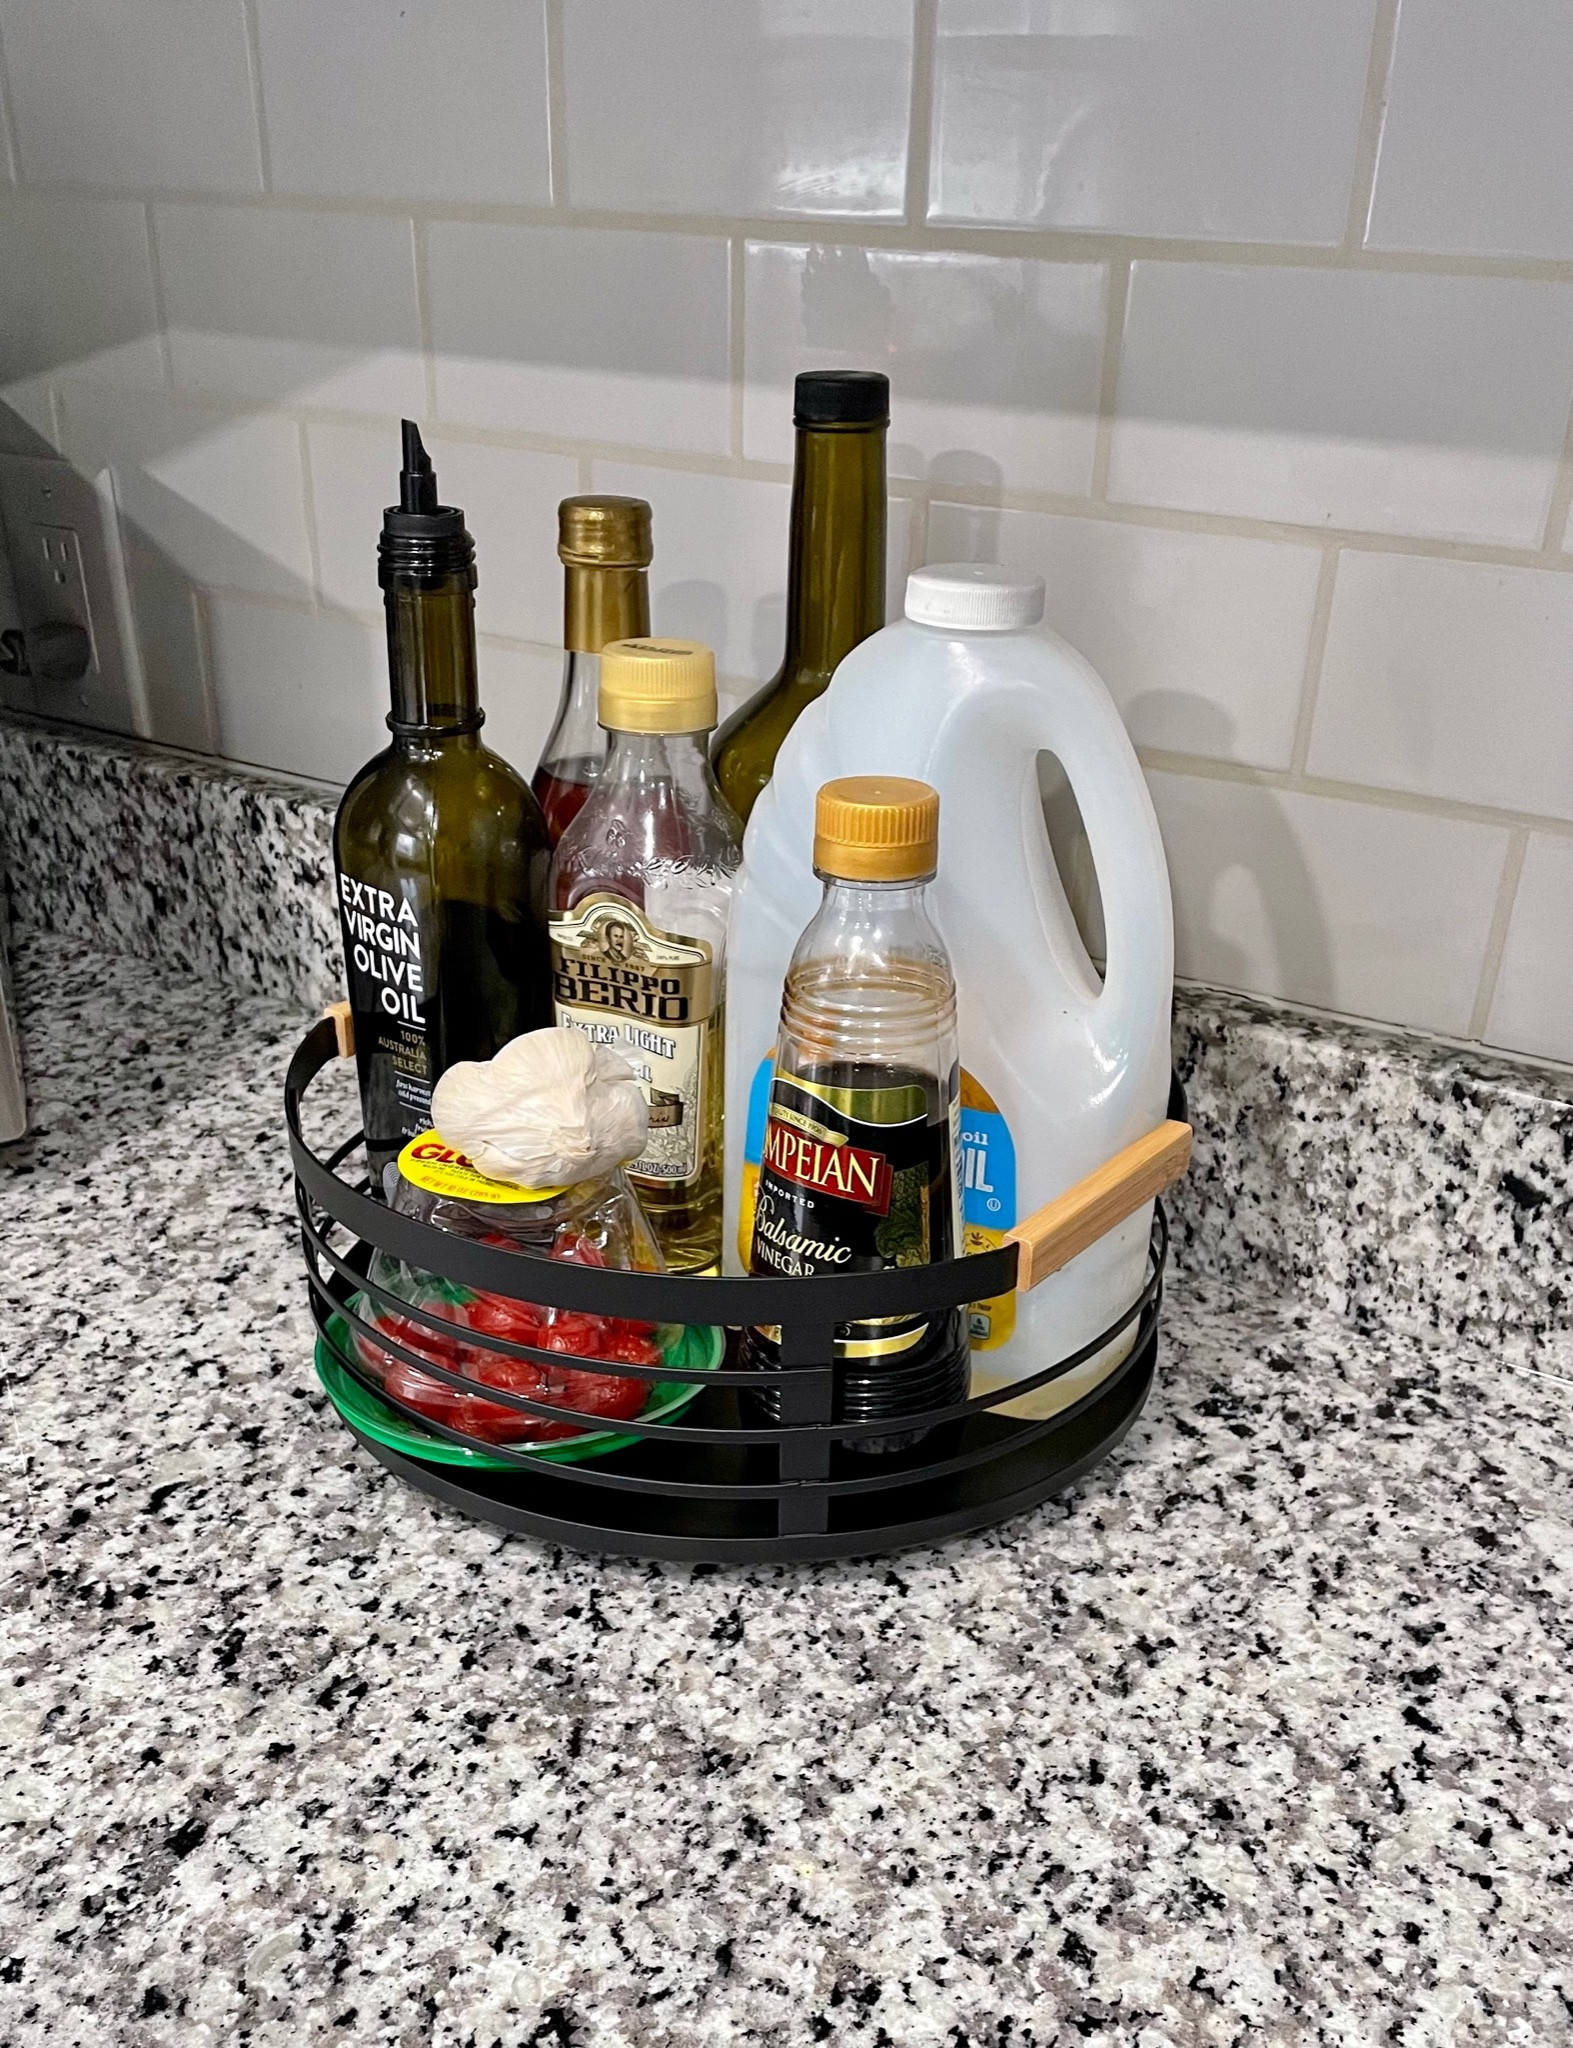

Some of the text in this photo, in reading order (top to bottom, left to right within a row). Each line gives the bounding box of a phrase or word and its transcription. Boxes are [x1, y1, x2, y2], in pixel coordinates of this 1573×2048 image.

[340, 872, 418, 927] EXTRA
[344, 906, 421, 960] VIRGIN
[354, 943, 424, 992] OLIVE
[559, 957, 681, 995] FILIPPO
[582, 954, 606, 963] SINCE
[380, 987, 426, 1024] OIL
[553, 970, 690, 1022] BERIO
[378, 1036, 427, 1061] AUSTRALIA
[400, 1030, 425, 1046] 100%
[624, 1024, 676, 1059] LIGHT
[392, 1055, 427, 1075] SELECT
[962, 1131, 989, 1146] oil
[764, 1122, 880, 1198] MPEIAN
[962, 1147, 994, 1193] IL
[765, 1179, 815, 1209] IMPORTED
[756, 1187, 852, 1264] Balsamic
[757, 1235, 815, 1276] VINEGAR
